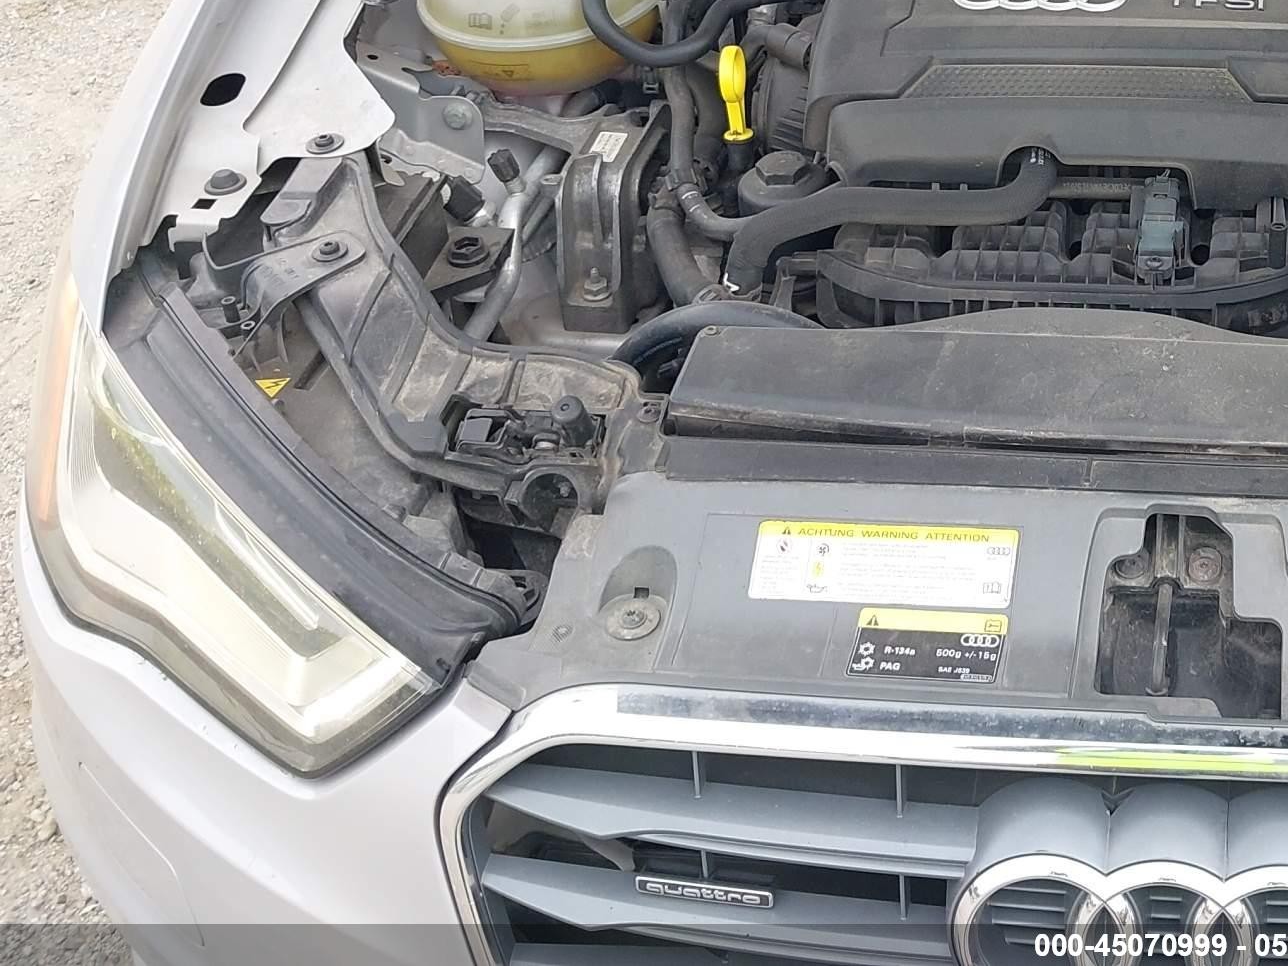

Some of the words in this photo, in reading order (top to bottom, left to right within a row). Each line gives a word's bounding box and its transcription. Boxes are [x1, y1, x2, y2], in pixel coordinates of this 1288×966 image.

[798, 527, 855, 538] ACHTUNG
[861, 529, 919, 540] WARNING
[925, 531, 990, 543] ATTENTION
[883, 645, 916, 656] R-134a
[936, 648, 962, 659] 500g
[879, 661, 901, 671] PAG
[645, 882, 761, 904] quattro
